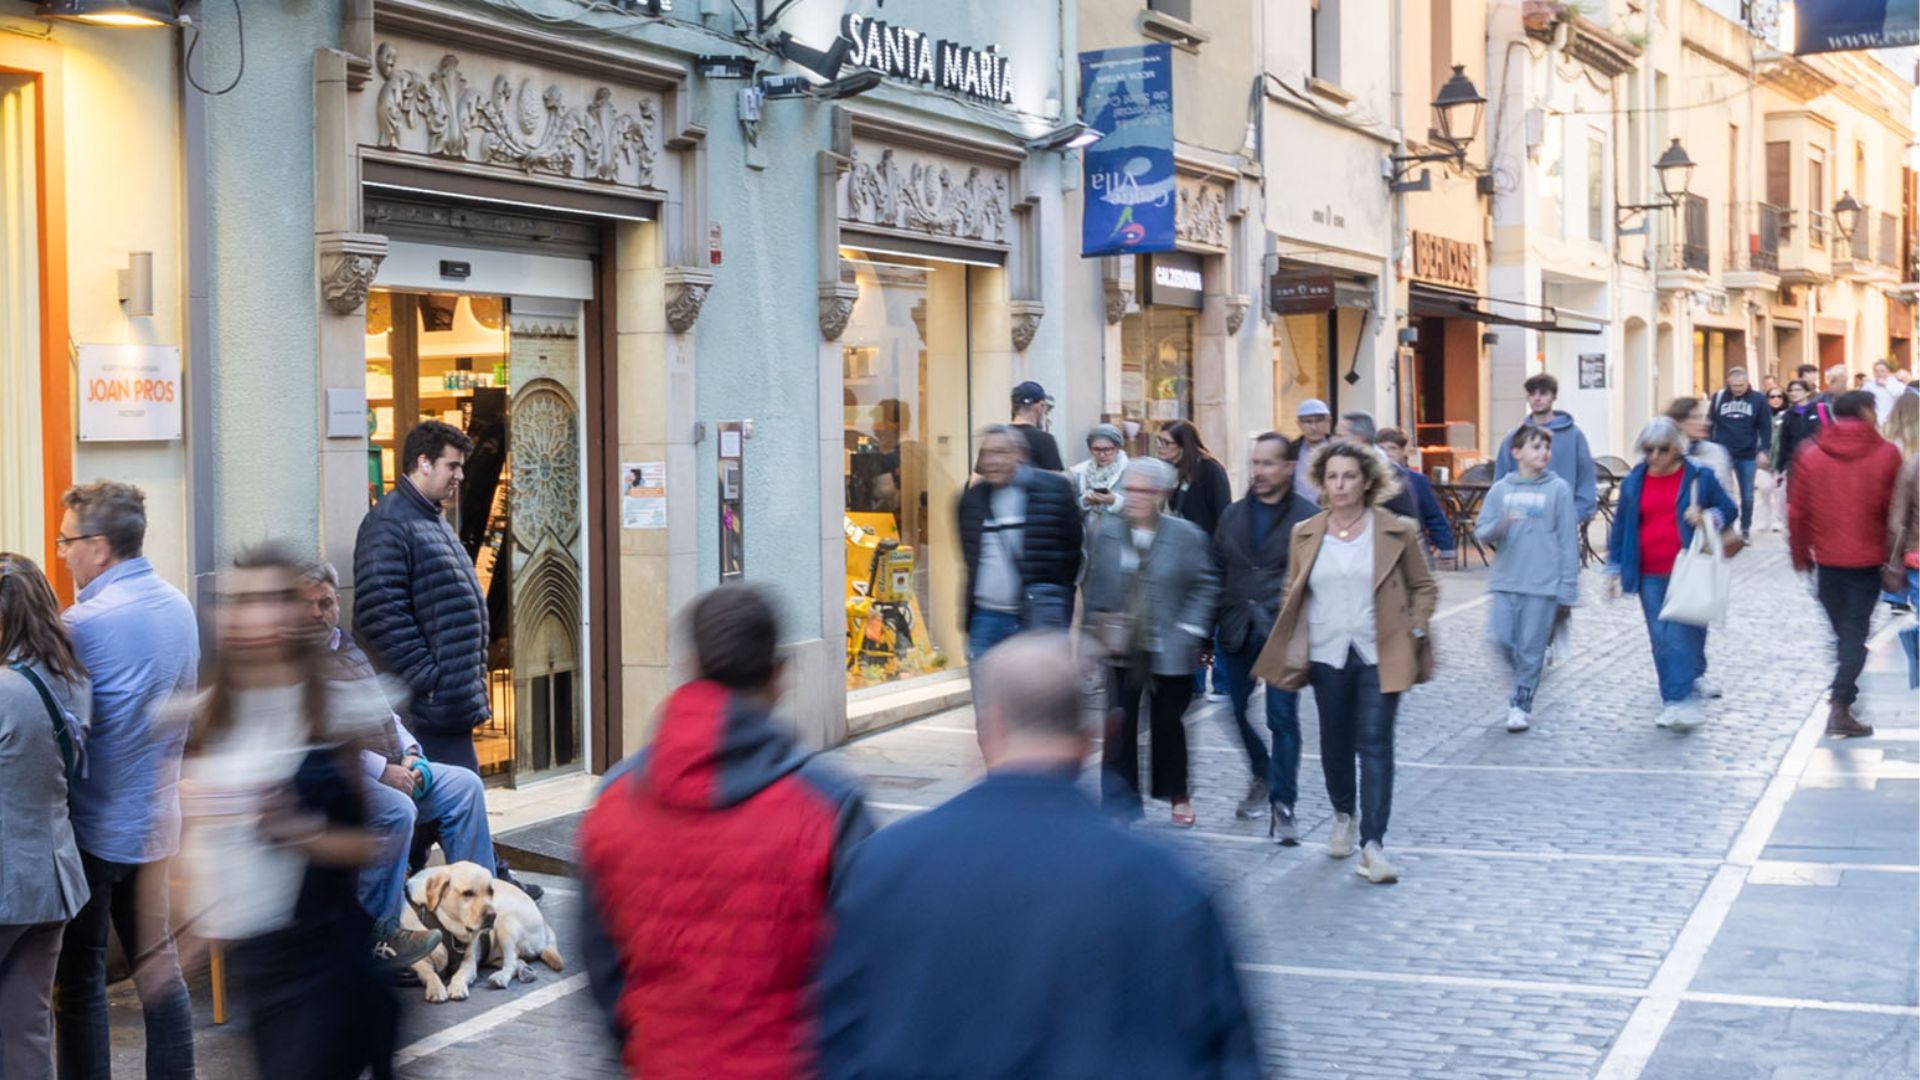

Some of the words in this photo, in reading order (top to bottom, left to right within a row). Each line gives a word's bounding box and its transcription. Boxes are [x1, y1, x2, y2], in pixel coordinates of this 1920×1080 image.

[845, 13, 935, 83] SANTA
[87, 378, 129, 402] JOAN
[134, 379, 175, 403] PROS
